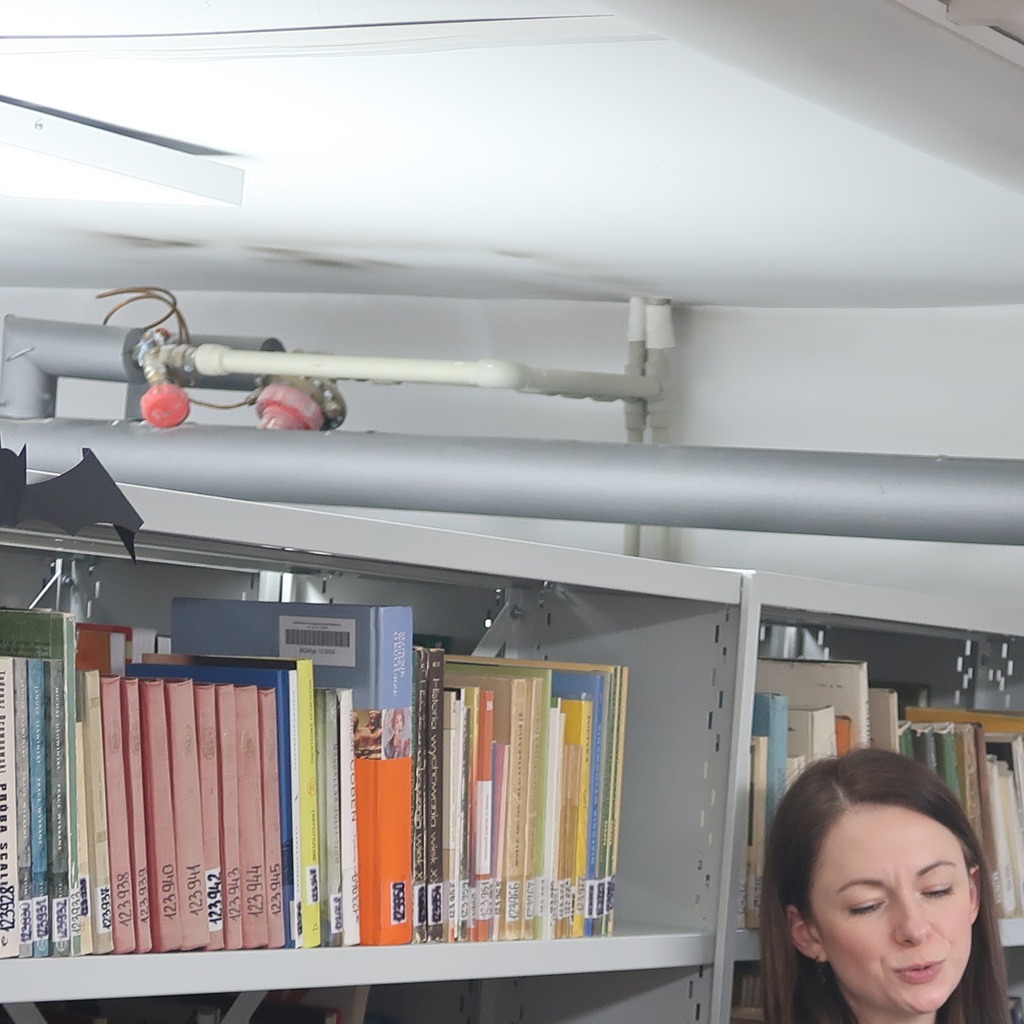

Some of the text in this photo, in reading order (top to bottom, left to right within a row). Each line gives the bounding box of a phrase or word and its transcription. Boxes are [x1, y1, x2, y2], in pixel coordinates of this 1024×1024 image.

[0, 885, 15, 932] 123928
[116, 872, 132, 927] 123938
[138, 867, 150, 925] 123939
[162, 864, 177, 920] 123940
[186, 864, 203, 917] 123941
[207, 872, 222, 925] 123942
[228, 867, 240, 921] 123943
[246, 864, 263, 918] 123944
[270, 863, 281, 917] 123945
[35, 899, 48, 939] 123931
[56, 899, 68, 938] 123932
